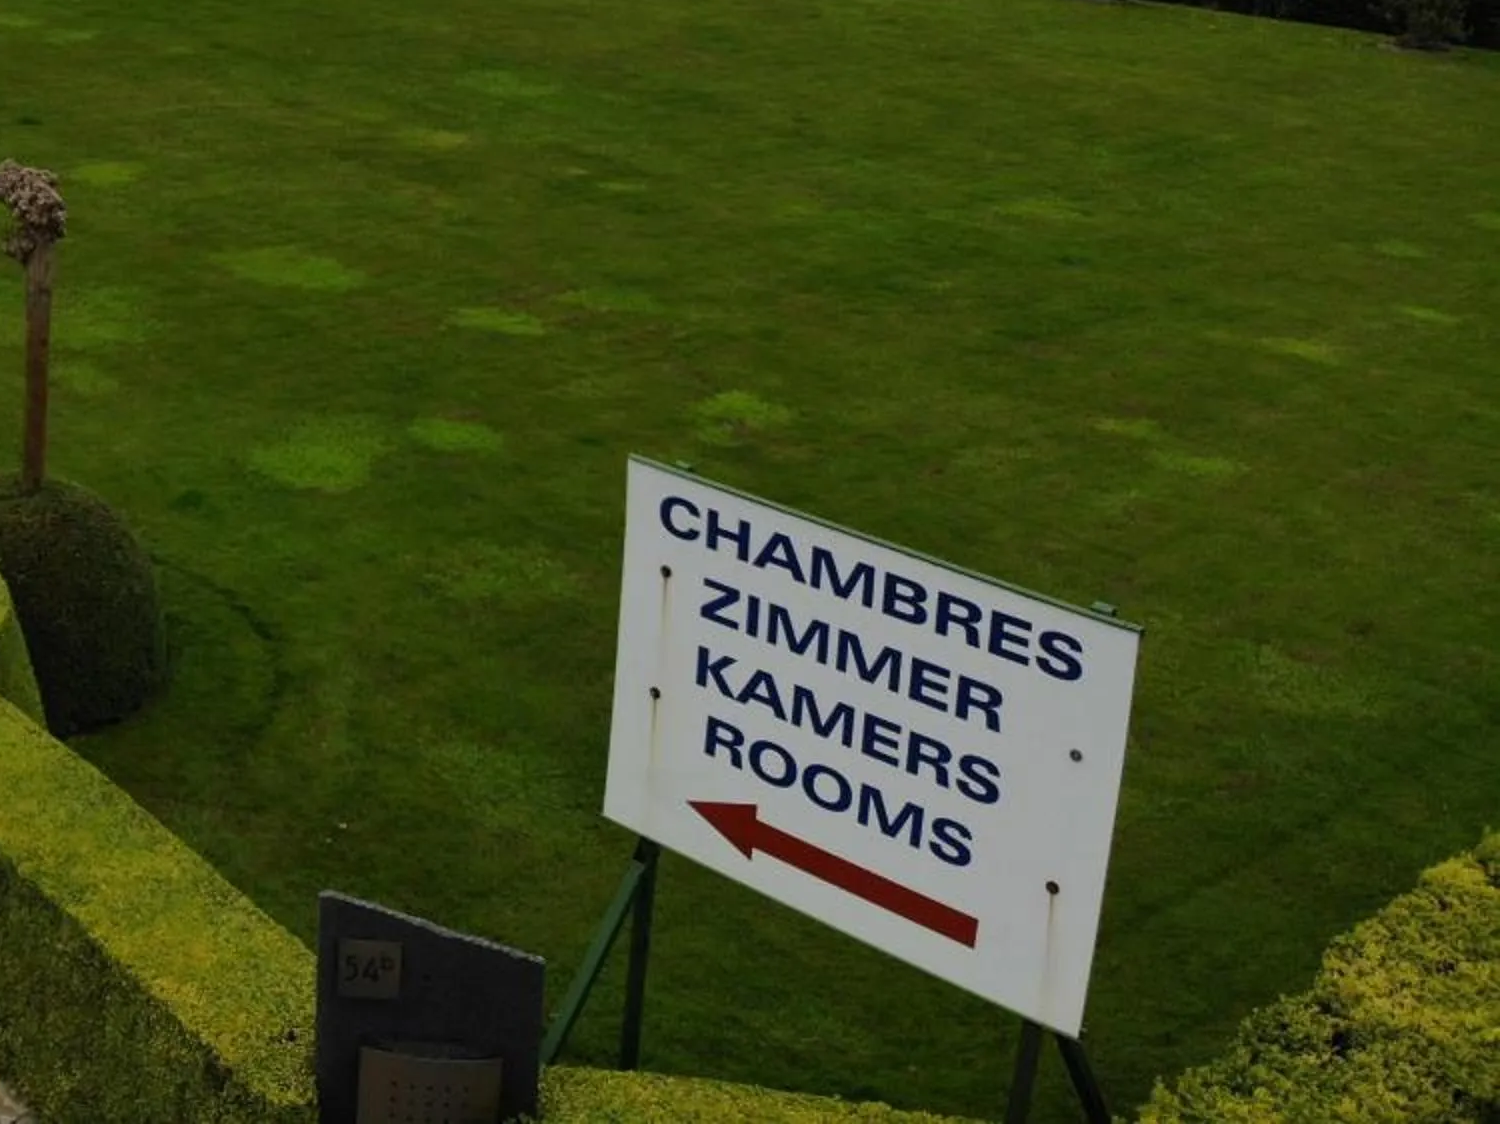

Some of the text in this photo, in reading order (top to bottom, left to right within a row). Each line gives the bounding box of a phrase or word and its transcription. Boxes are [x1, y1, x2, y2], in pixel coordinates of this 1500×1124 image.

[659, 495, 1084, 682] CHAMBRES
[699, 578, 1004, 733] ZIMMER
[695, 646, 1002, 805] KAMERS
[704, 716, 974, 867] ROOMS
